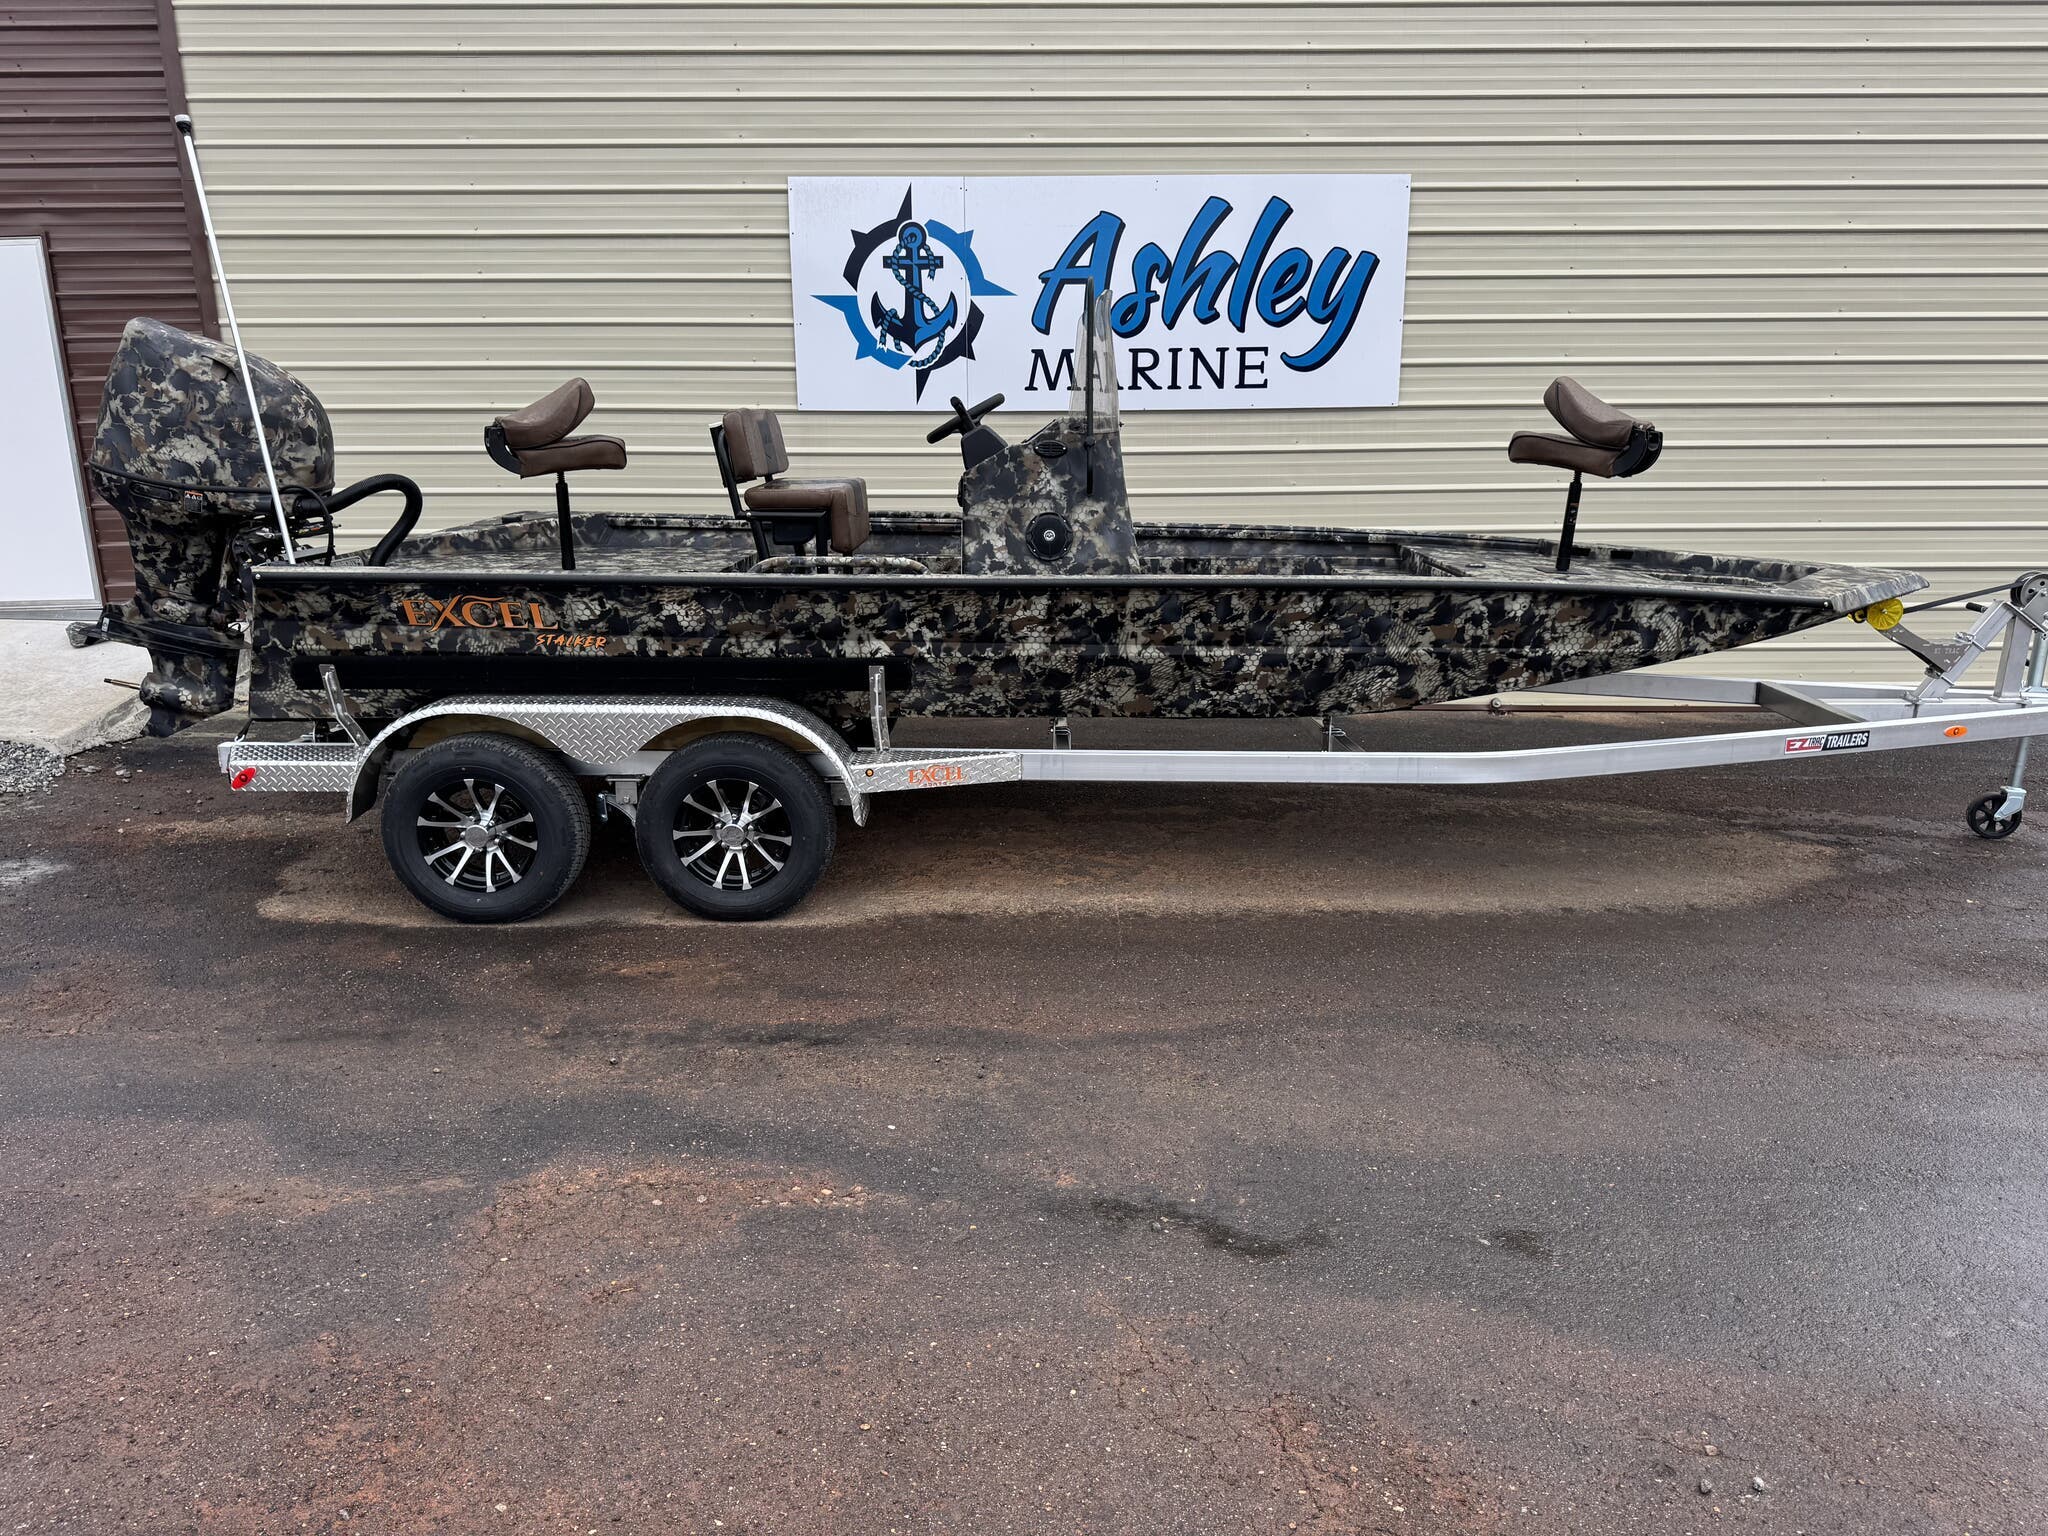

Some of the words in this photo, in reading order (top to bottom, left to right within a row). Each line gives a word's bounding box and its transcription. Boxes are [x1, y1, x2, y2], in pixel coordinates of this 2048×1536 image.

[1031, 195, 1380, 372] Ashley
[1024, 346, 1269, 391] MARINE
[401, 594, 559, 633] EXCEL
[535, 633, 607, 649] STALKER
[1826, 732, 1869, 749] TRAILERS
[908, 764, 968, 785] EXCEL
